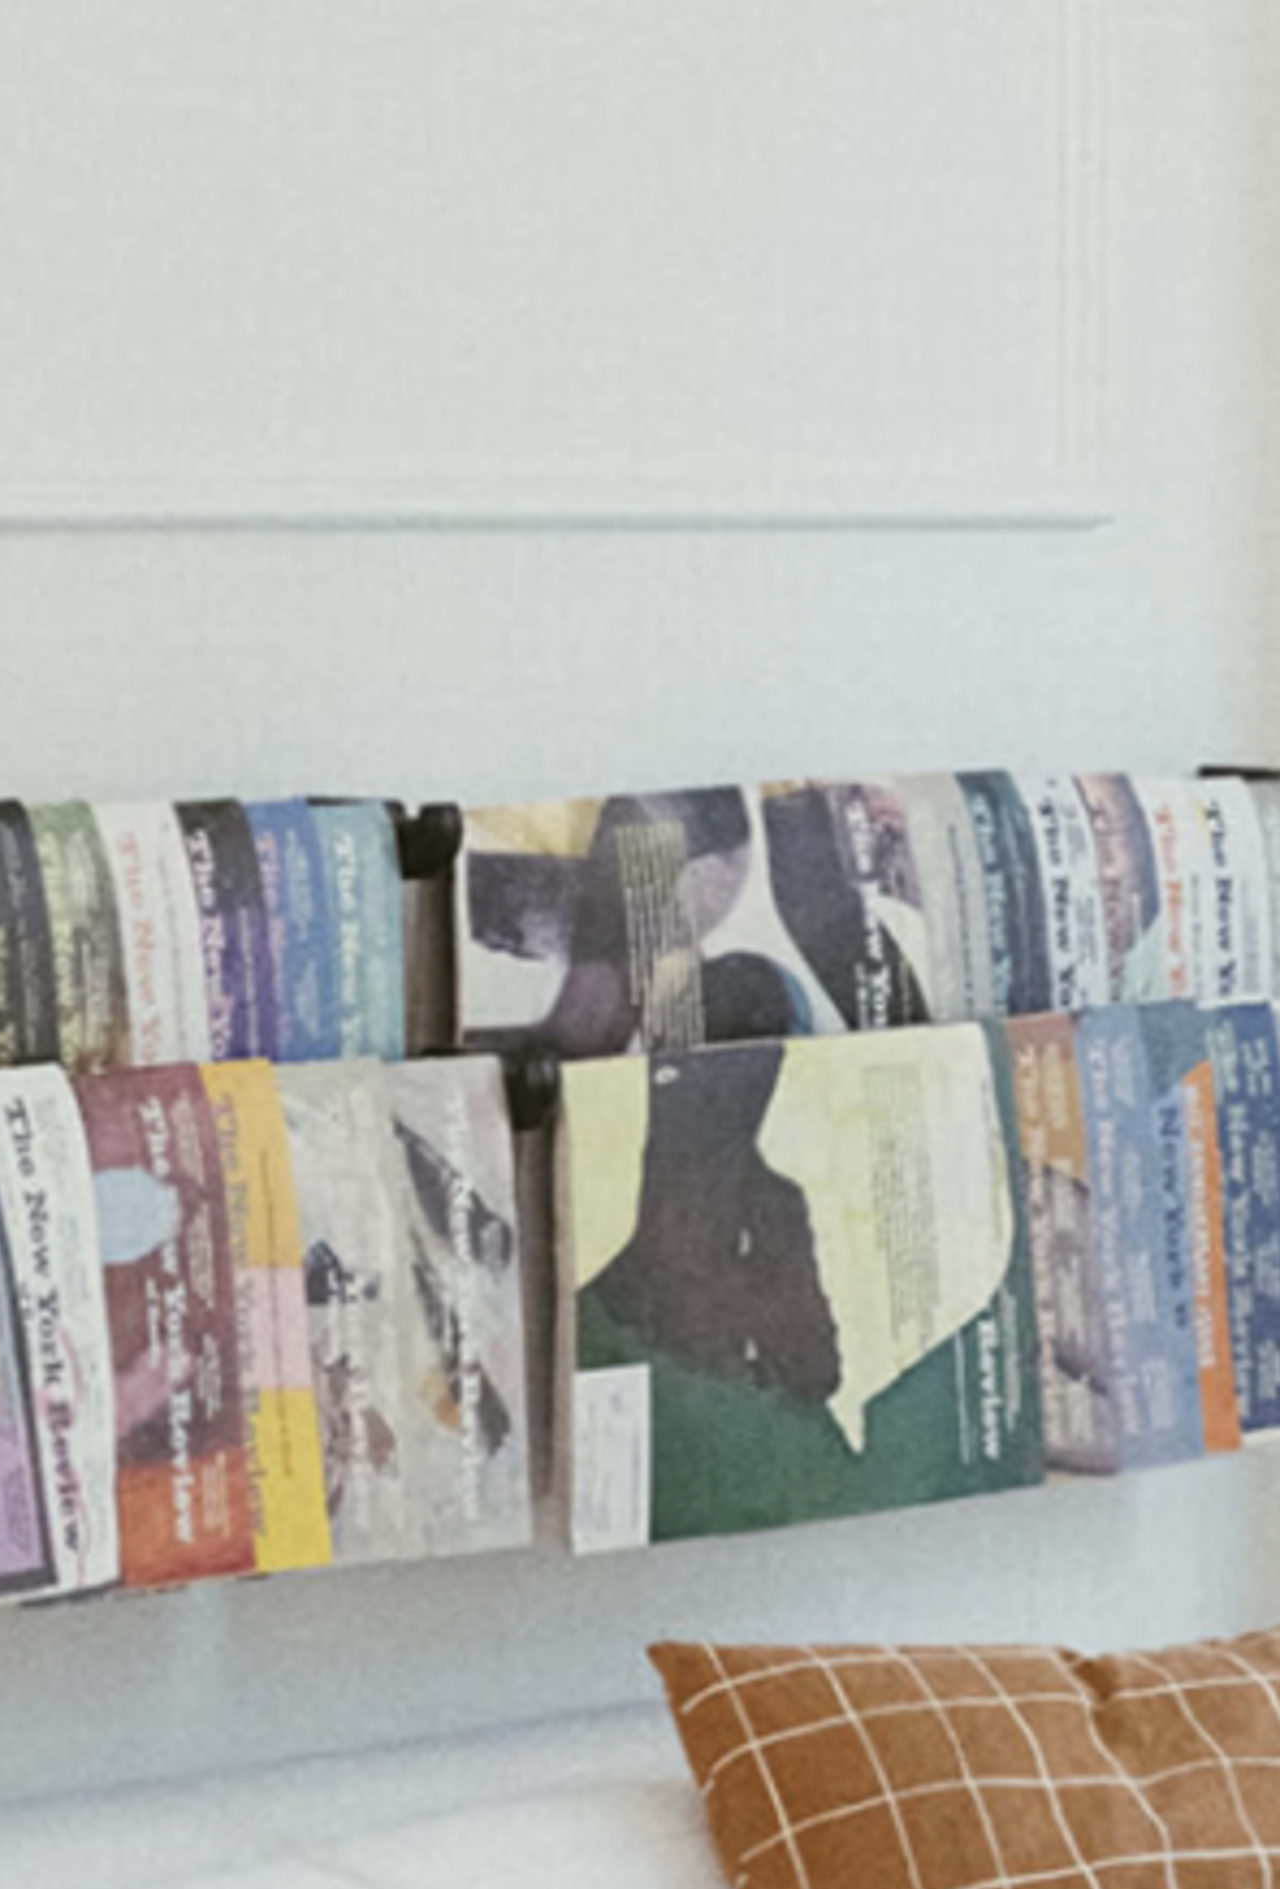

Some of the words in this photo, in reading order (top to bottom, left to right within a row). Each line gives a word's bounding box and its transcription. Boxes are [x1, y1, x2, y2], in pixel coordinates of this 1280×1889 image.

[187, 828, 217, 908] The
[336, 831, 358, 912] The
[846, 799, 873, 873] The
[1039, 798, 1065, 865] The
[1052, 878, 1074, 952] New
[1155, 804, 1177, 873] The
[1205, 800, 1231, 867] The
[117, 833, 144, 911] The
[132, 920, 157, 1004] New
[986, 872, 1005, 949] New
[1164, 880, 1185, 952] New
[1216, 876, 1235, 952] New
[55, 920, 74, 1007] New
[200, 915, 227, 1004] New
[340, 921, 361, 1004] New
[3, 1098, 34, 1177] The
[138, 1097, 169, 1175] The
[1157, 1104, 1186, 1191] New
[21, 1188, 51, 1279] New
[1163, 1198, 1190, 1290] York
[38, 1287, 66, 1388] York
[162, 1281, 190, 1386] York
[977, 1320, 1004, 1459] Review
[44, 1400, 81, 1555] Review
[167, 1391, 196, 1542] Review
